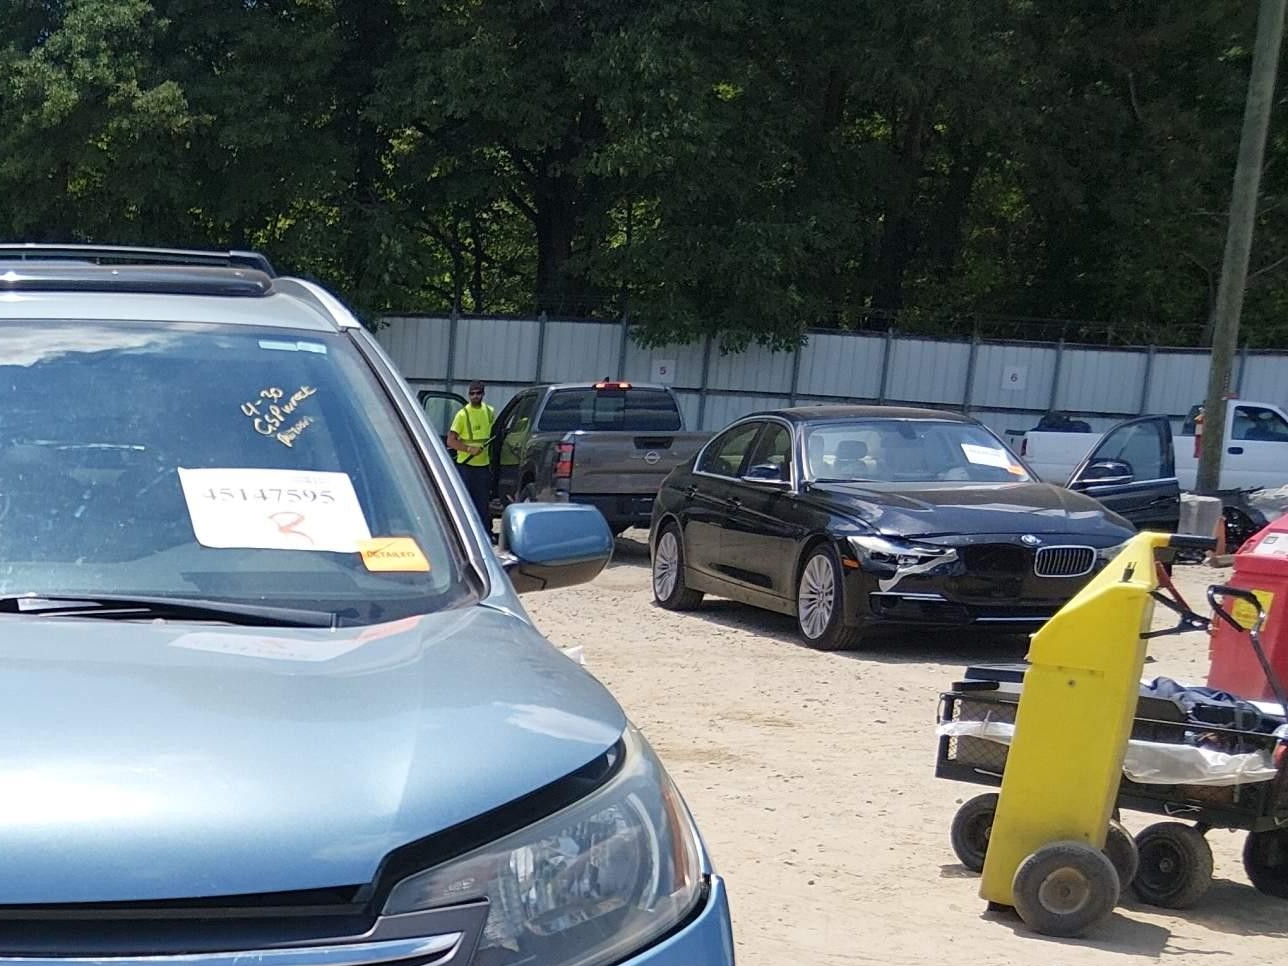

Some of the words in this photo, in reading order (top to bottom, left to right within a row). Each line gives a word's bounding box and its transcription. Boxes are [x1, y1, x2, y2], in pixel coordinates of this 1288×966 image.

[659, 366, 667, 375] 5
[1010, 372, 1018, 382] 6
[203, 488, 335, 505] 45147595
